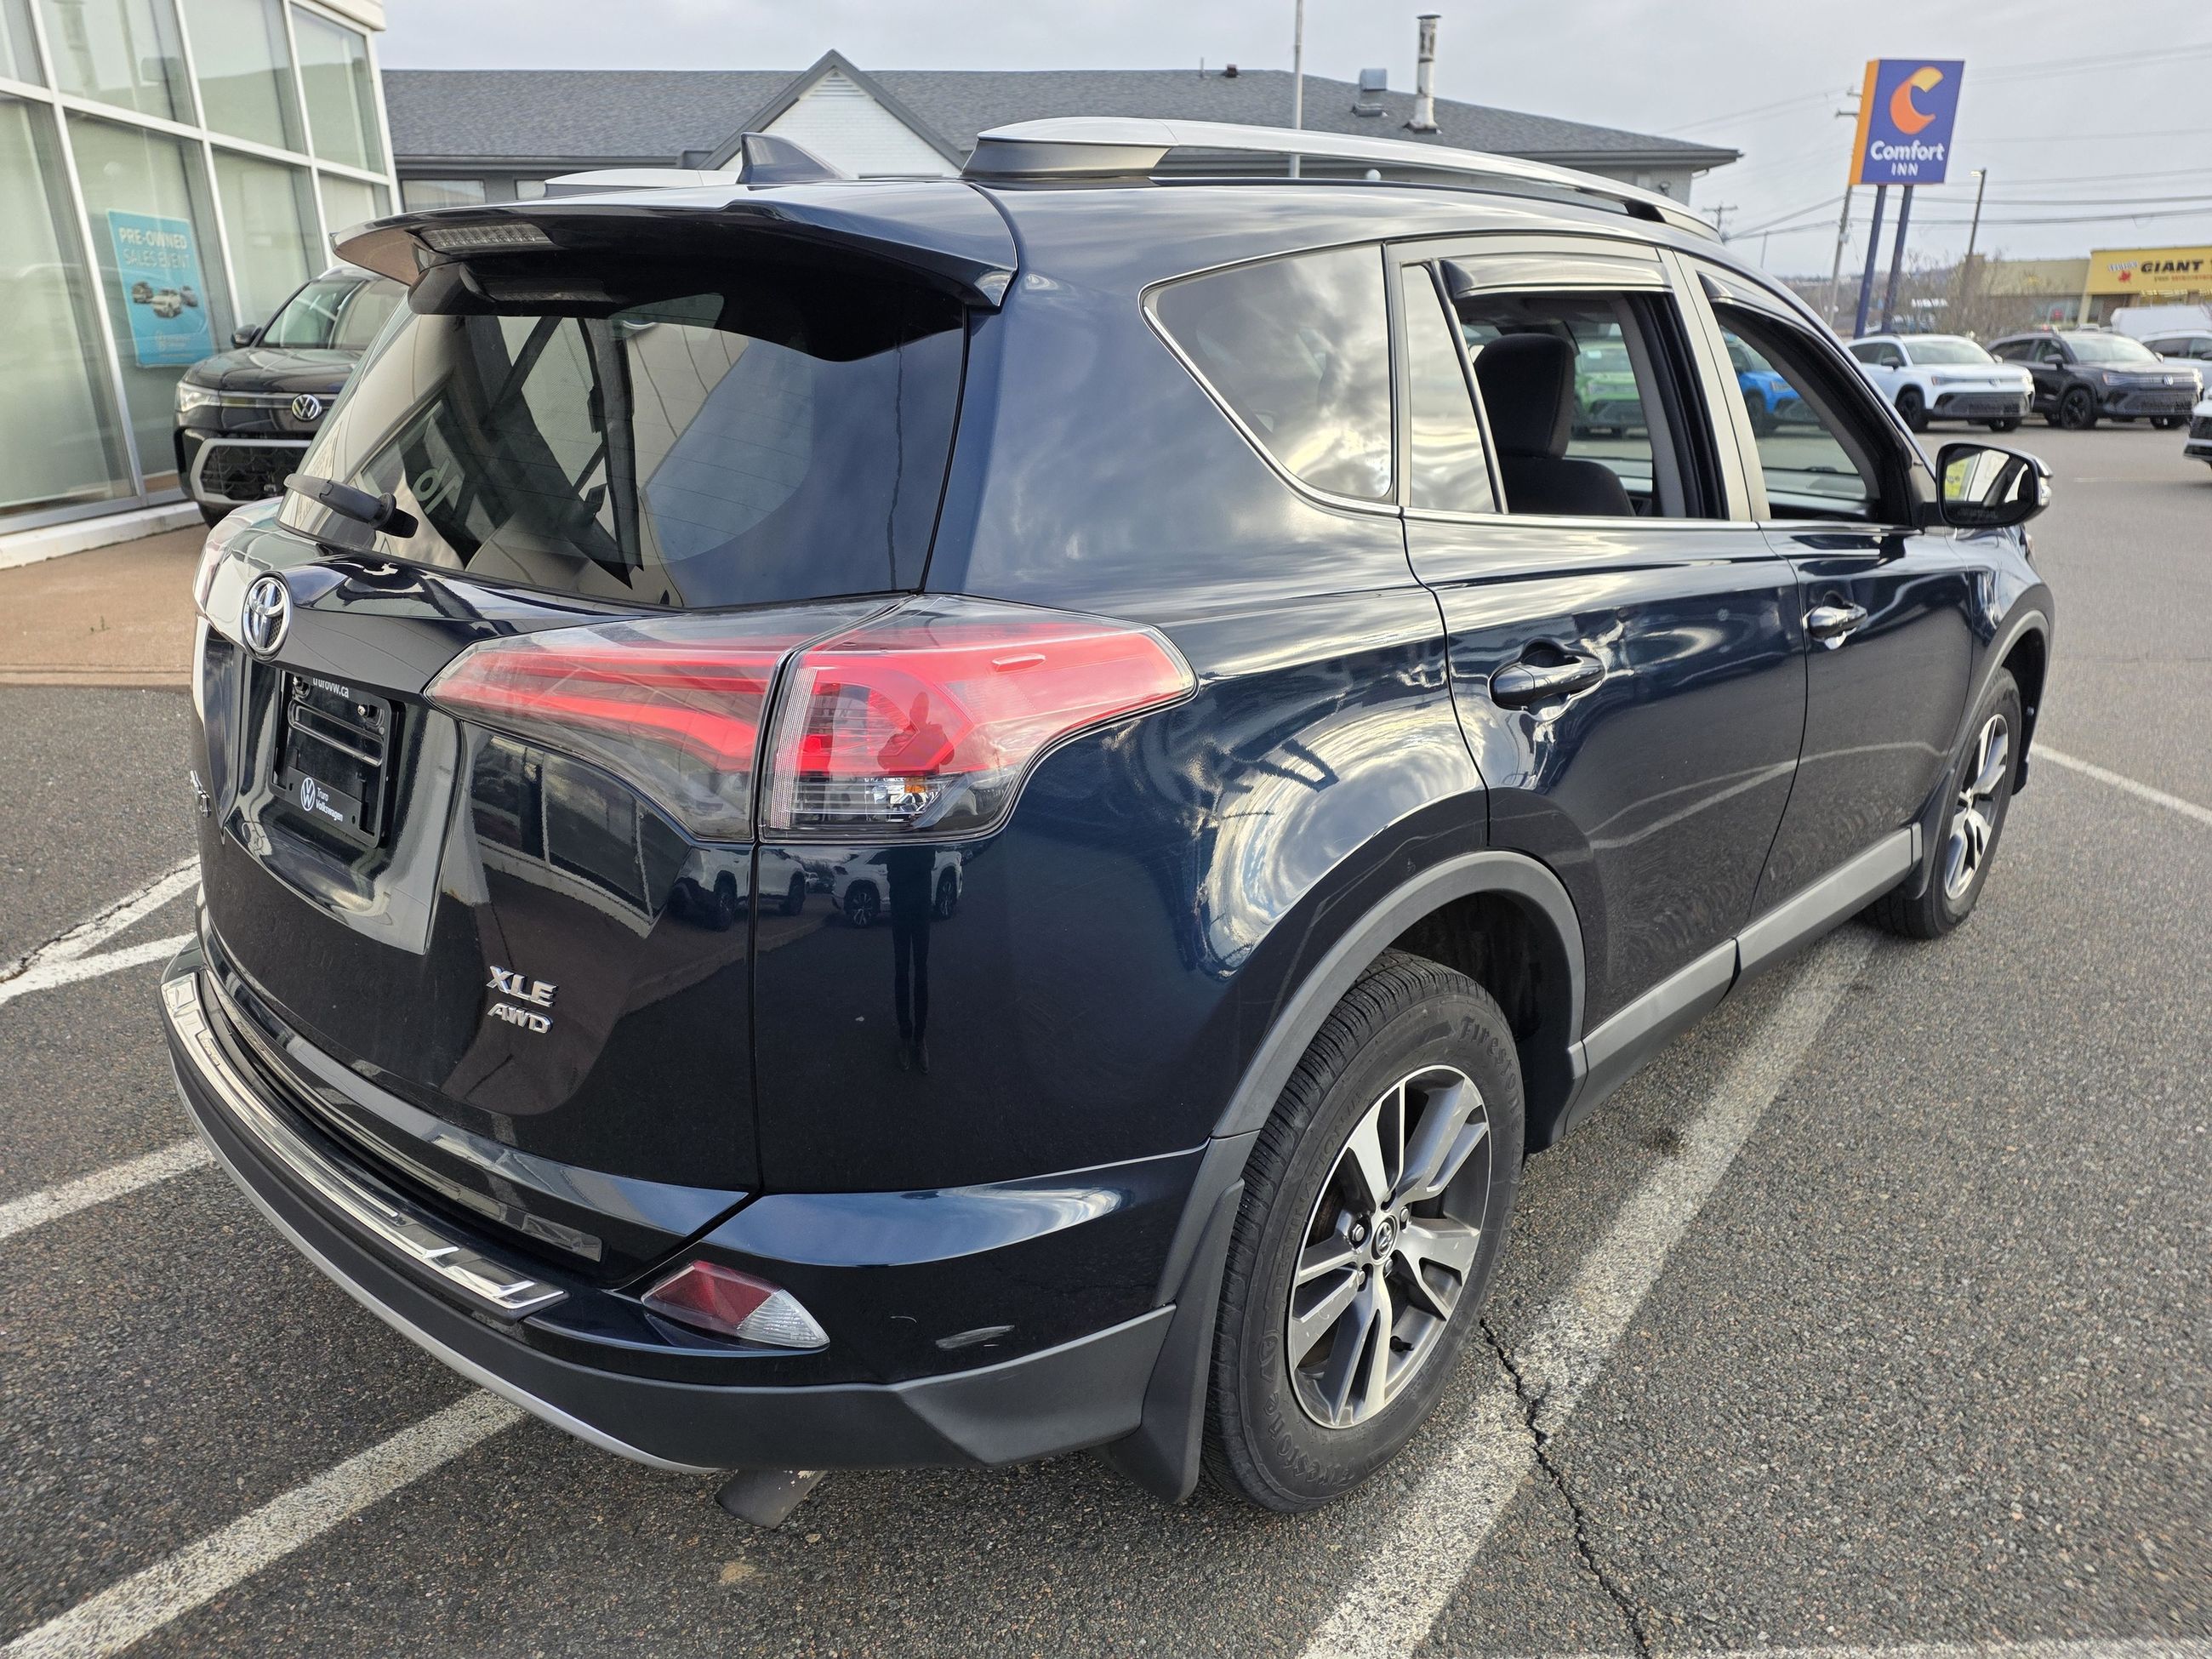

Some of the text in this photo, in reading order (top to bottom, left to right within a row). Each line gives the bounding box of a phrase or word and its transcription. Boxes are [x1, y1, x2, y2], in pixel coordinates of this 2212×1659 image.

[1870, 140, 1945, 161] Comfort
[1891, 162, 1918, 176] INN
[118, 227, 187, 249] PRE-OWNED
[123, 248, 157, 267] SALES
[2141, 258, 2203, 273] GIANT
[316, 787, 329, 801] Truro
[316, 798, 343, 822] Volkswagen
[486, 966, 558, 1007] XLE
[487, 1002, 553, 1034] AWD
